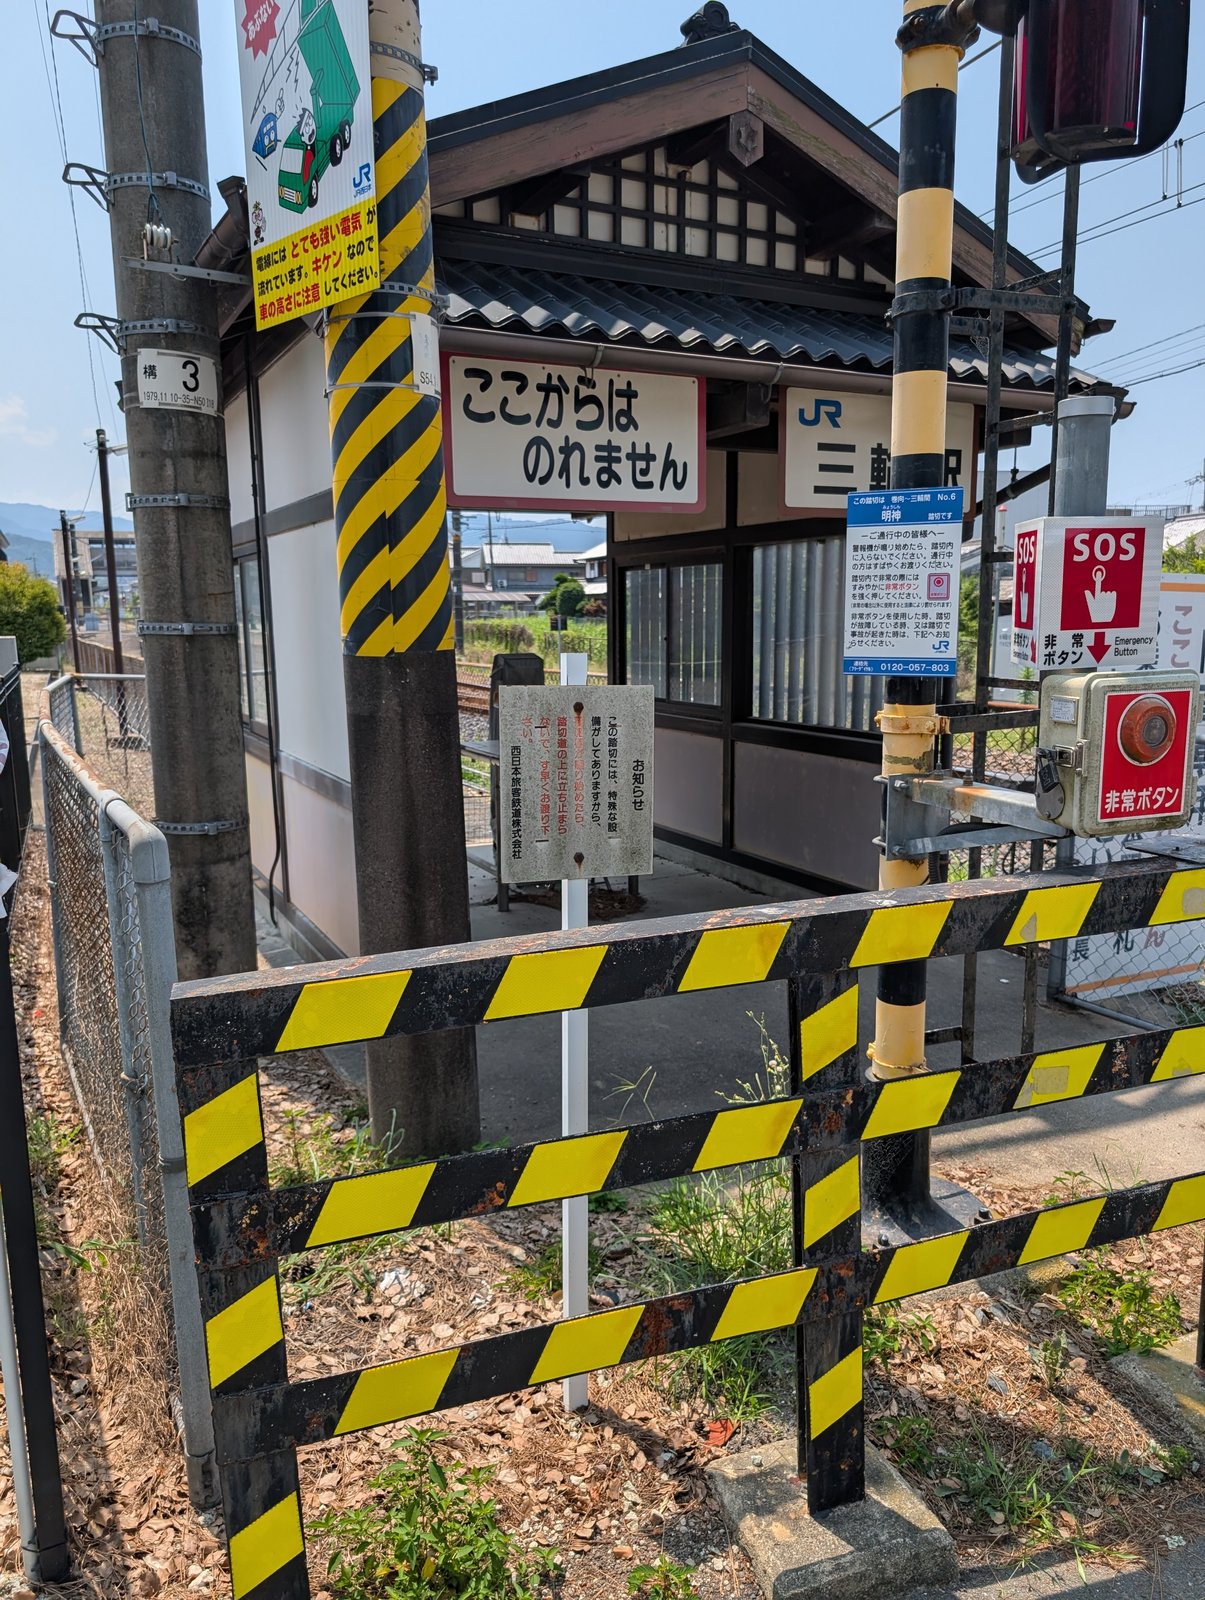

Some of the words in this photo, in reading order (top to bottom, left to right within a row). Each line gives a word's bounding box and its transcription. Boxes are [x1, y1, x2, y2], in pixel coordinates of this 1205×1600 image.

[353, 162, 371, 188] JR
[256, 247, 287, 272] 電線には
[291, 211, 362, 259] とても強い電気
[366, 205, 376, 224] が
[258, 265, 308, 297] 流れています。
[312, 250, 342, 276] キケン
[347, 236, 374, 260] なので
[259, 283, 320, 321] 車の高さに注意
[325, 265, 378, 296] してください。
[143, 364, 157, 379] 構
[182, 360, 199, 392] 3
[463, 367, 639, 432] ここからは
[799, 399, 842, 428] JR
[523, 435, 688, 491] のれません
[853, 496, 885, 505] この踏切は
[937, 493, 956, 501] No.6
[881, 509, 901, 522] 明神
[928, 512, 953, 521] 踏切です
[1018, 535, 1035, 565] SOS
[1073, 533, 1136, 562] SOS
[852, 560, 954, 570] の方はすばやくお渡りください。
[851, 574, 919, 583] 踏切内で非常の際には
[851, 583, 919, 591] すみやかに非常ボタン
[851, 592, 922, 601] を強く押してください。
[851, 612, 951, 621] 非常ボタンを使用した時、踏切
[851, 621, 950, 630] が故障している時、又は踏切で
[850, 630, 950, 639] 事故が起きた時は、下記へお知
[850, 640, 895, 648] らせください。
[932, 640, 950, 651] JR
[1114, 636, 1153, 646] Emergency
[1043, 650, 1083, 666] ボタン
[1113, 647, 1138, 657] Button
[880, 663, 949, 672] 0120-057-803
[557, 716, 568, 835] 踏切道の上に立ち止まら
[591, 716, 602, 827] 備がしてありますから、
[607, 716, 618, 833] この踏切には、特殊な設
[632, 759, 645, 811] お知らせ
[510, 745, 522, 860] 西日本旅客鉄道株式会社
[1105, 786, 1180, 813] 非常ボタン
